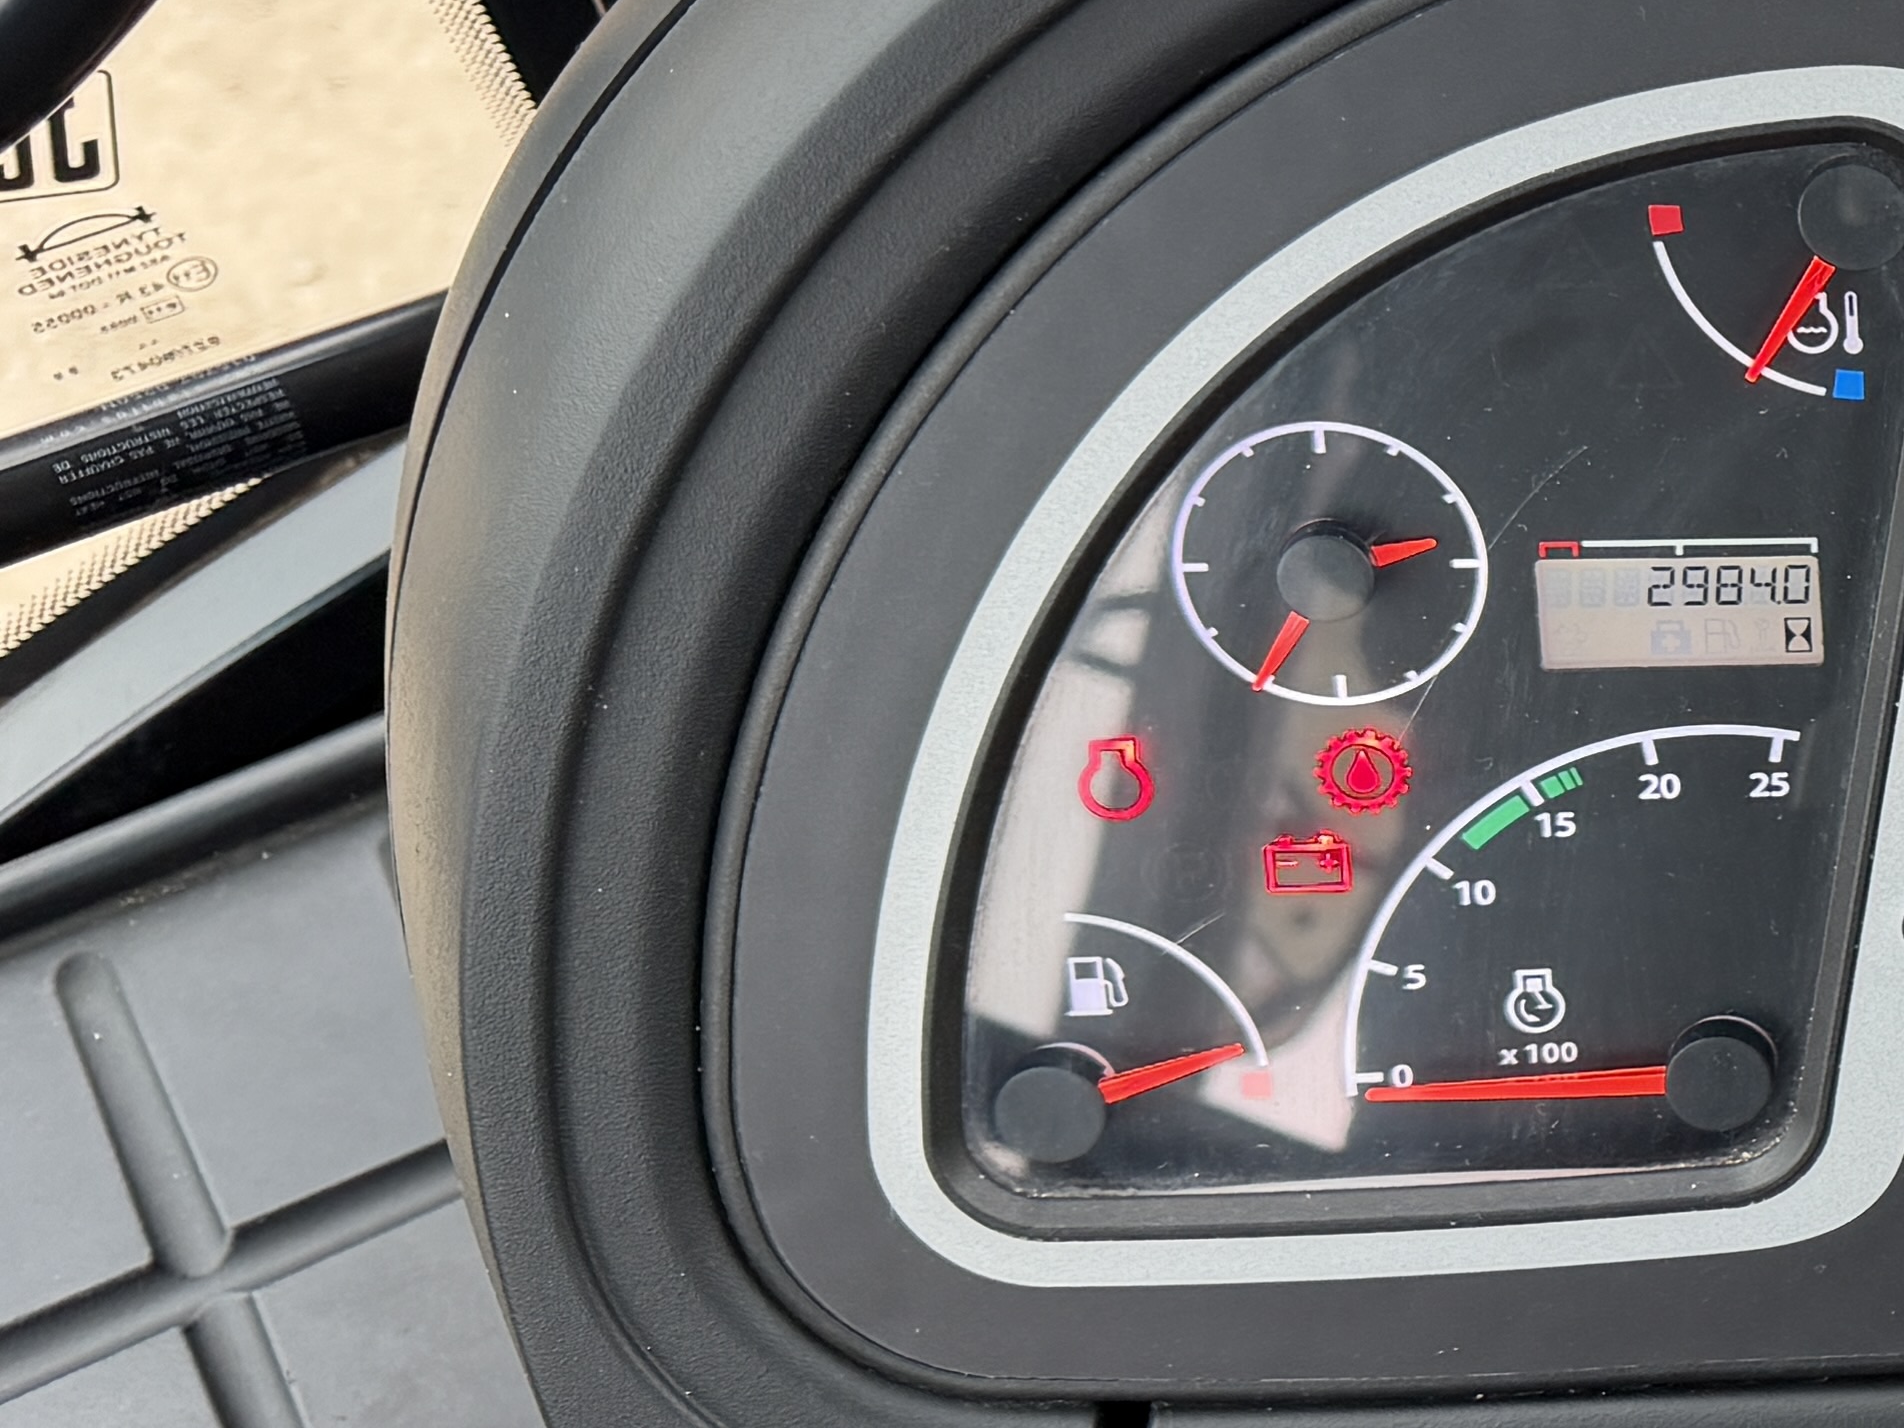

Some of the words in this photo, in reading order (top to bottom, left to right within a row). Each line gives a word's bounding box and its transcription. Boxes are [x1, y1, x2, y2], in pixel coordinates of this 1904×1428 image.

[1638, 773, 1681, 800] 20
[1749, 771, 1790, 798] 25
[1534, 811, 1577, 838] 15
[1453, 879, 1496, 906] 10
[1402, 964, 1427, 991] 5
[1392, 1064, 1414, 1087] 0
